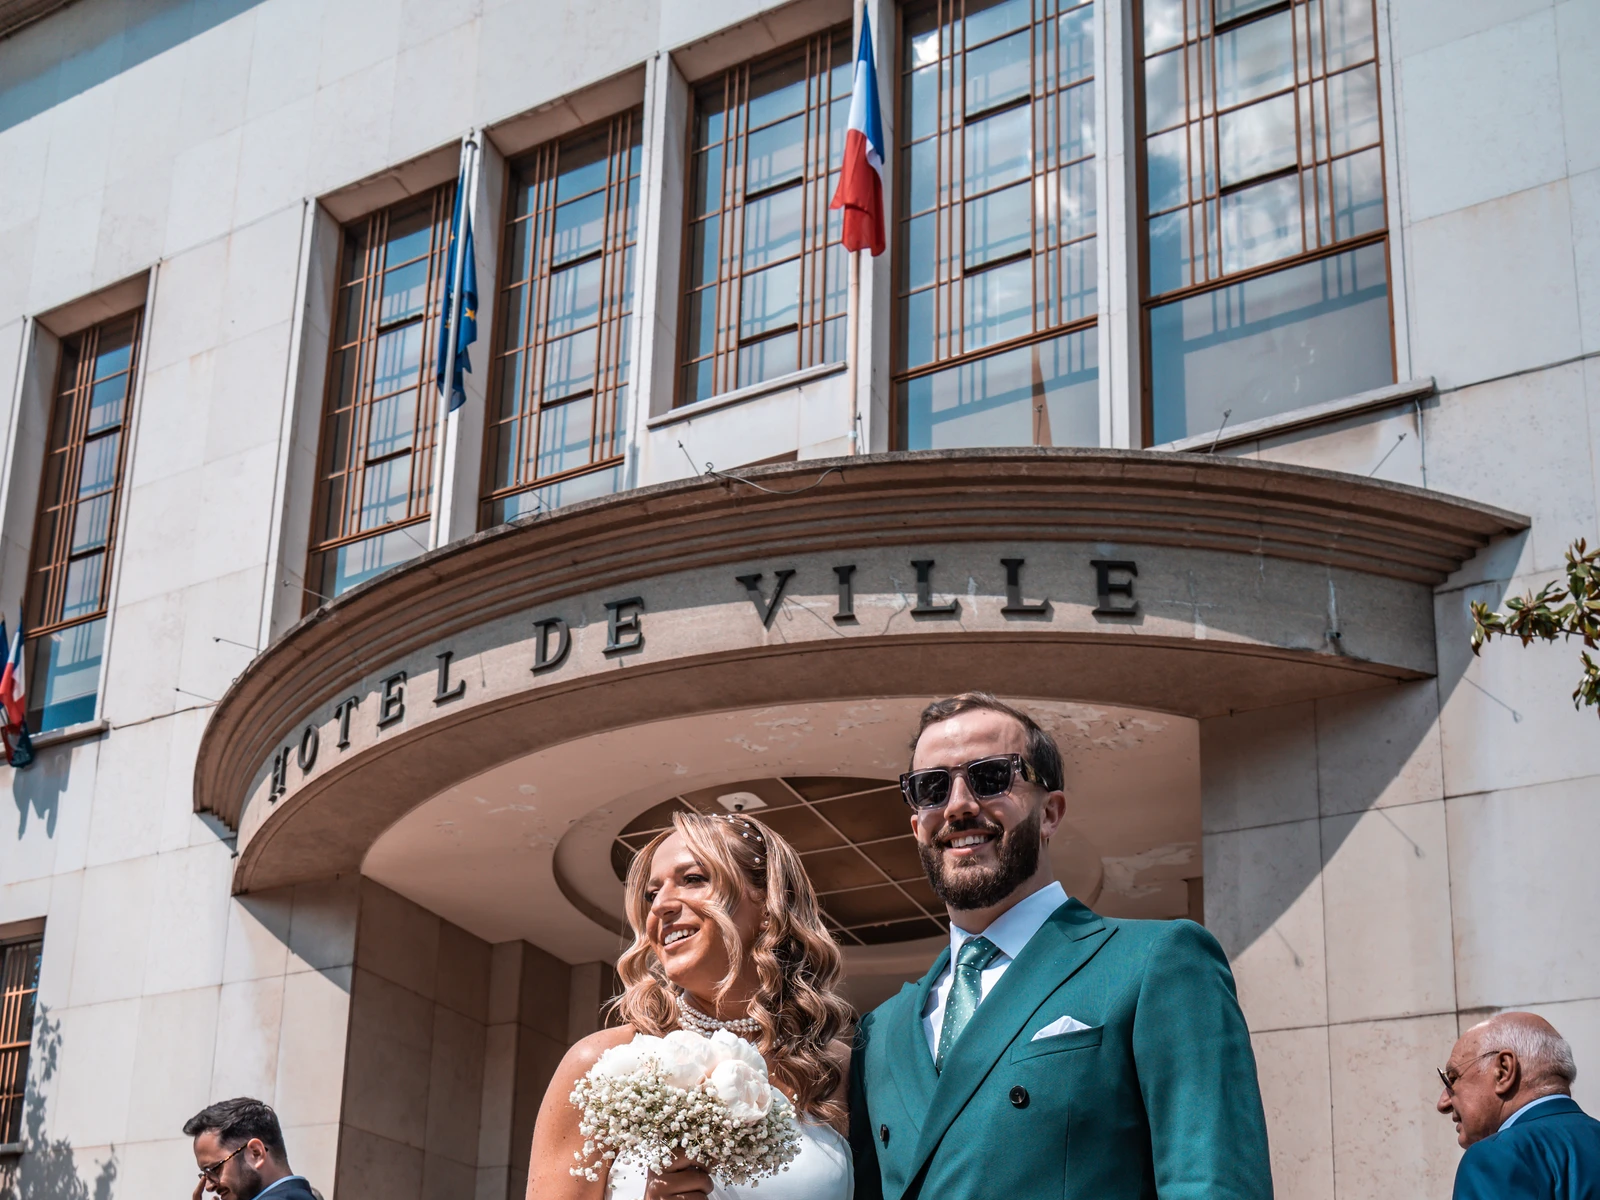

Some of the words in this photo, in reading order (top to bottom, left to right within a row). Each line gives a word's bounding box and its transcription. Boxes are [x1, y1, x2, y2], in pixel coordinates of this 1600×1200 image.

[268, 651, 466, 802] HOTEL
[530, 596, 645, 673] DE
[735, 557, 1140, 630] VILLE
